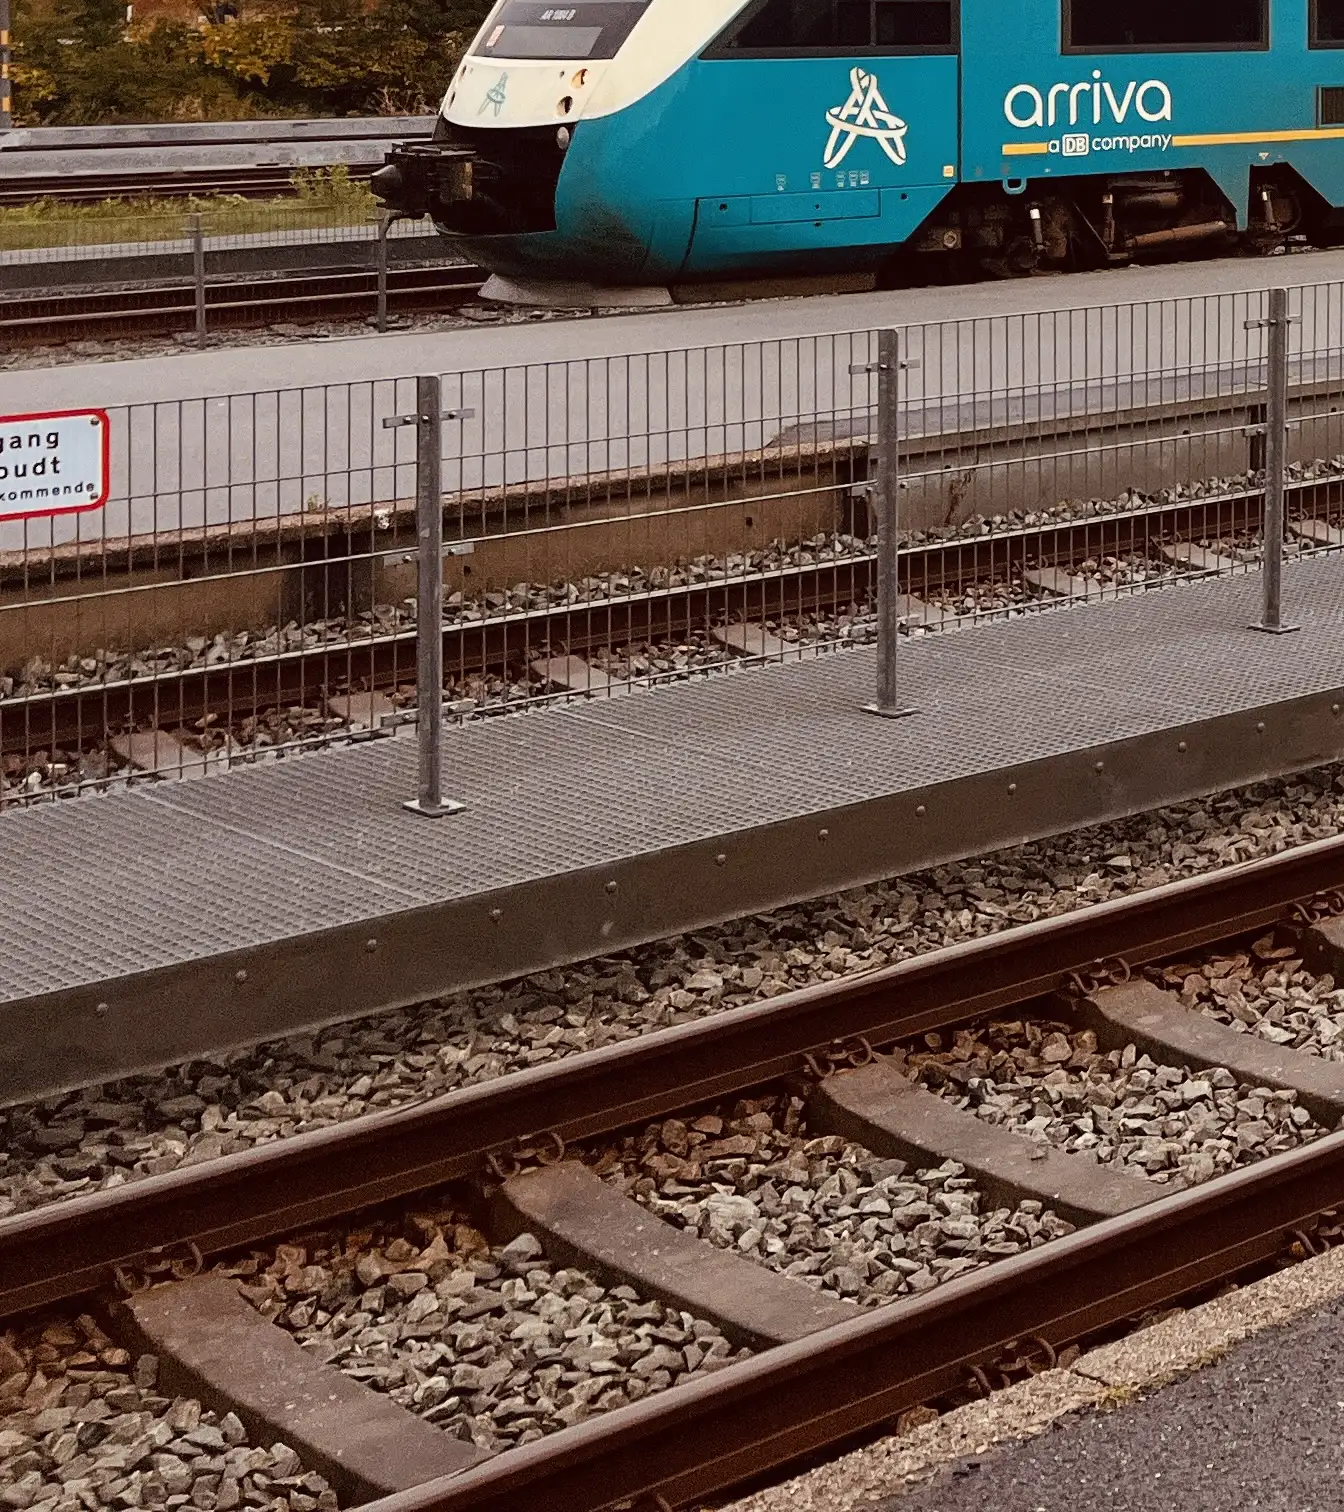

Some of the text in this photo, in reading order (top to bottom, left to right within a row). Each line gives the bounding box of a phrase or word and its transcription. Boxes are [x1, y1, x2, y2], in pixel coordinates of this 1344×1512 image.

[1004, 69, 1171, 128] arriva
[1048, 133, 1172, 153] a DB company
[0, 431, 59, 455] ang
